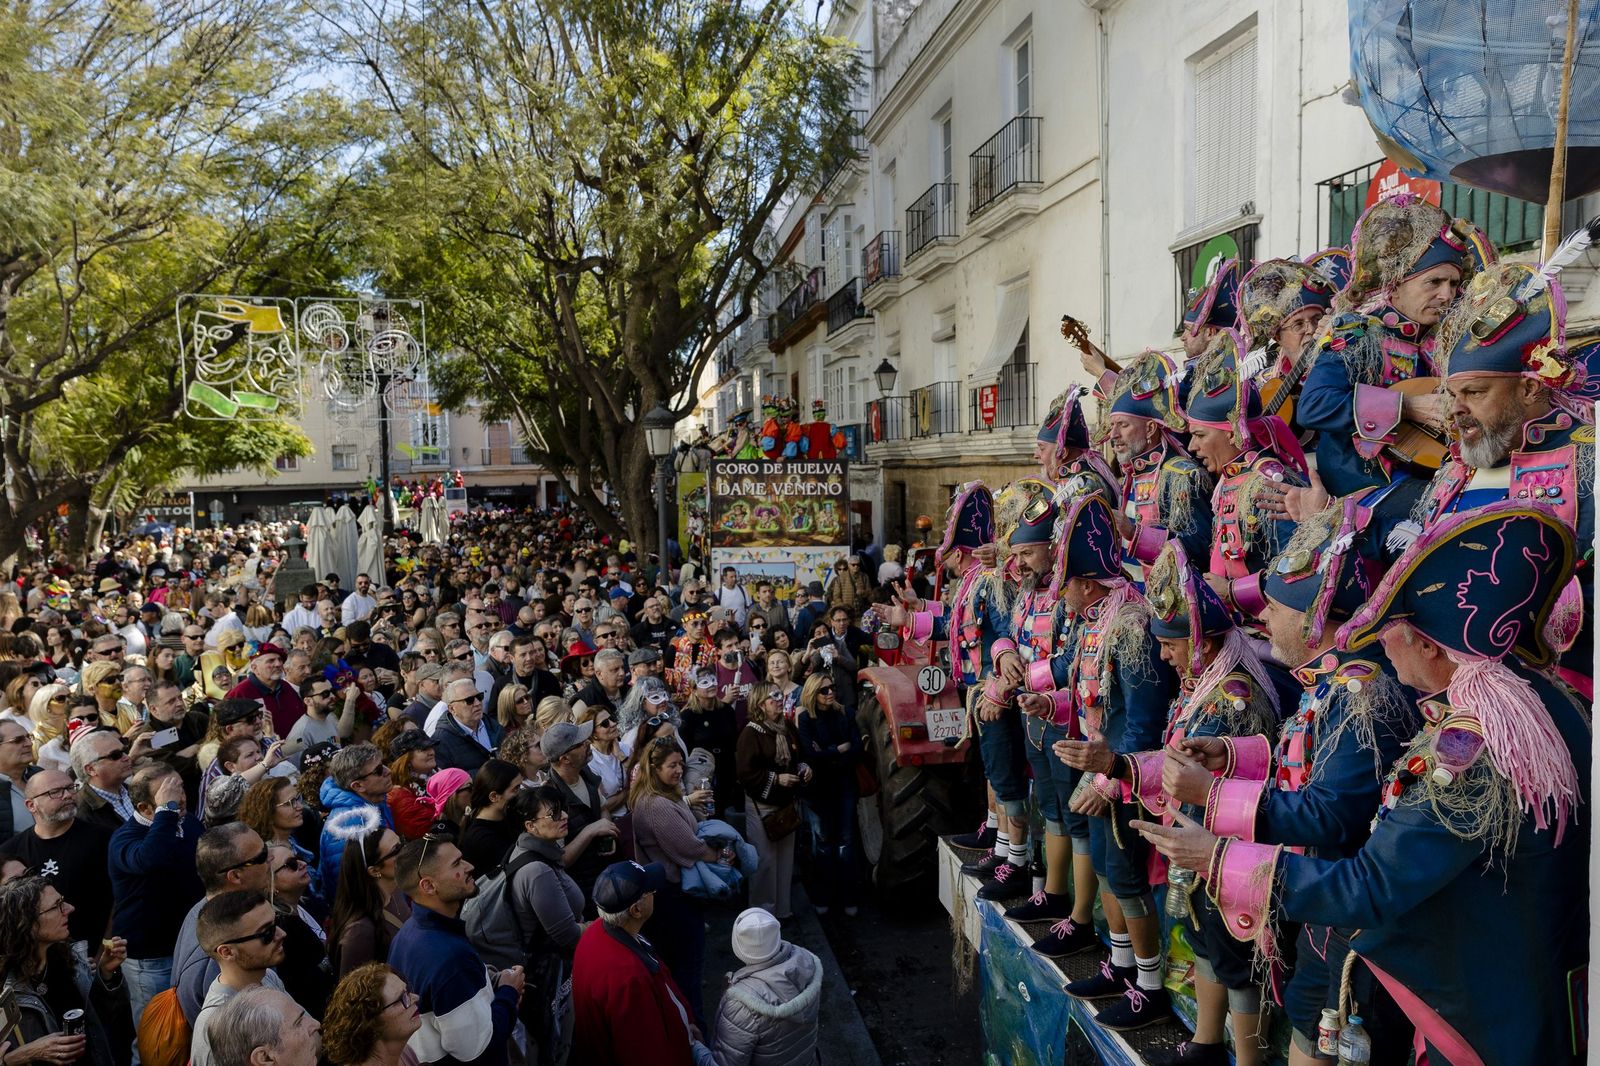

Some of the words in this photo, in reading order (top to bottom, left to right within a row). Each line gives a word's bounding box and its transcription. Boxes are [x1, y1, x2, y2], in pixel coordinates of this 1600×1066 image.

[716, 463, 759, 475] CORO
[764, 463, 783, 474] DE
[787, 463, 843, 475] HUELVA
[718, 482, 767, 496] DAME
[772, 482, 843, 496] VENENO
[141, 506, 192, 516] ATTOO
[922, 668, 941, 692] 30
